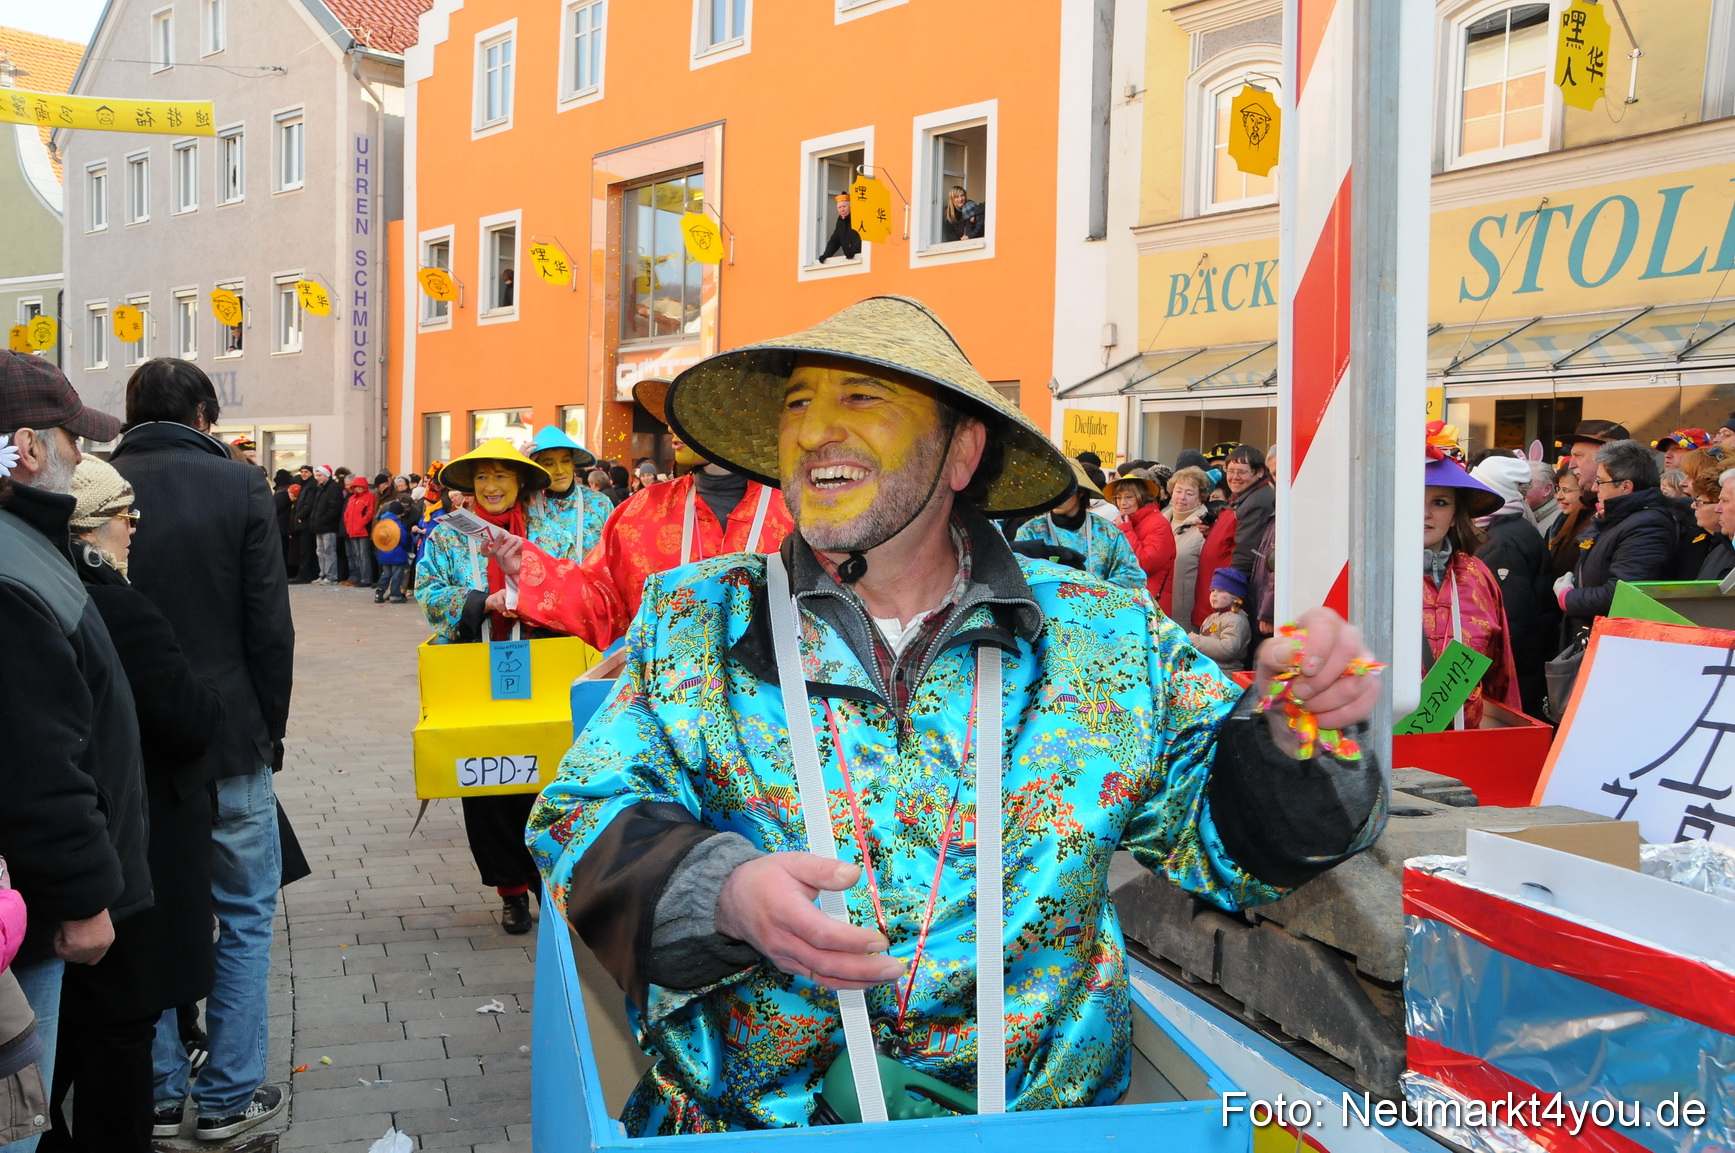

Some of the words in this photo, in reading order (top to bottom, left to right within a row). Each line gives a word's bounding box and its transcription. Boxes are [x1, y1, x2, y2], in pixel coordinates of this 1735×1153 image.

[356, 137, 369, 235] UHREN
[1163, 258, 1280, 318] BÄCK
[353, 250, 368, 387] SCHMUCK
[1073, 414, 1108, 438] Dietfurter
[504, 677, 515, 691] P
[461, 755, 538, 786] SPD-7
